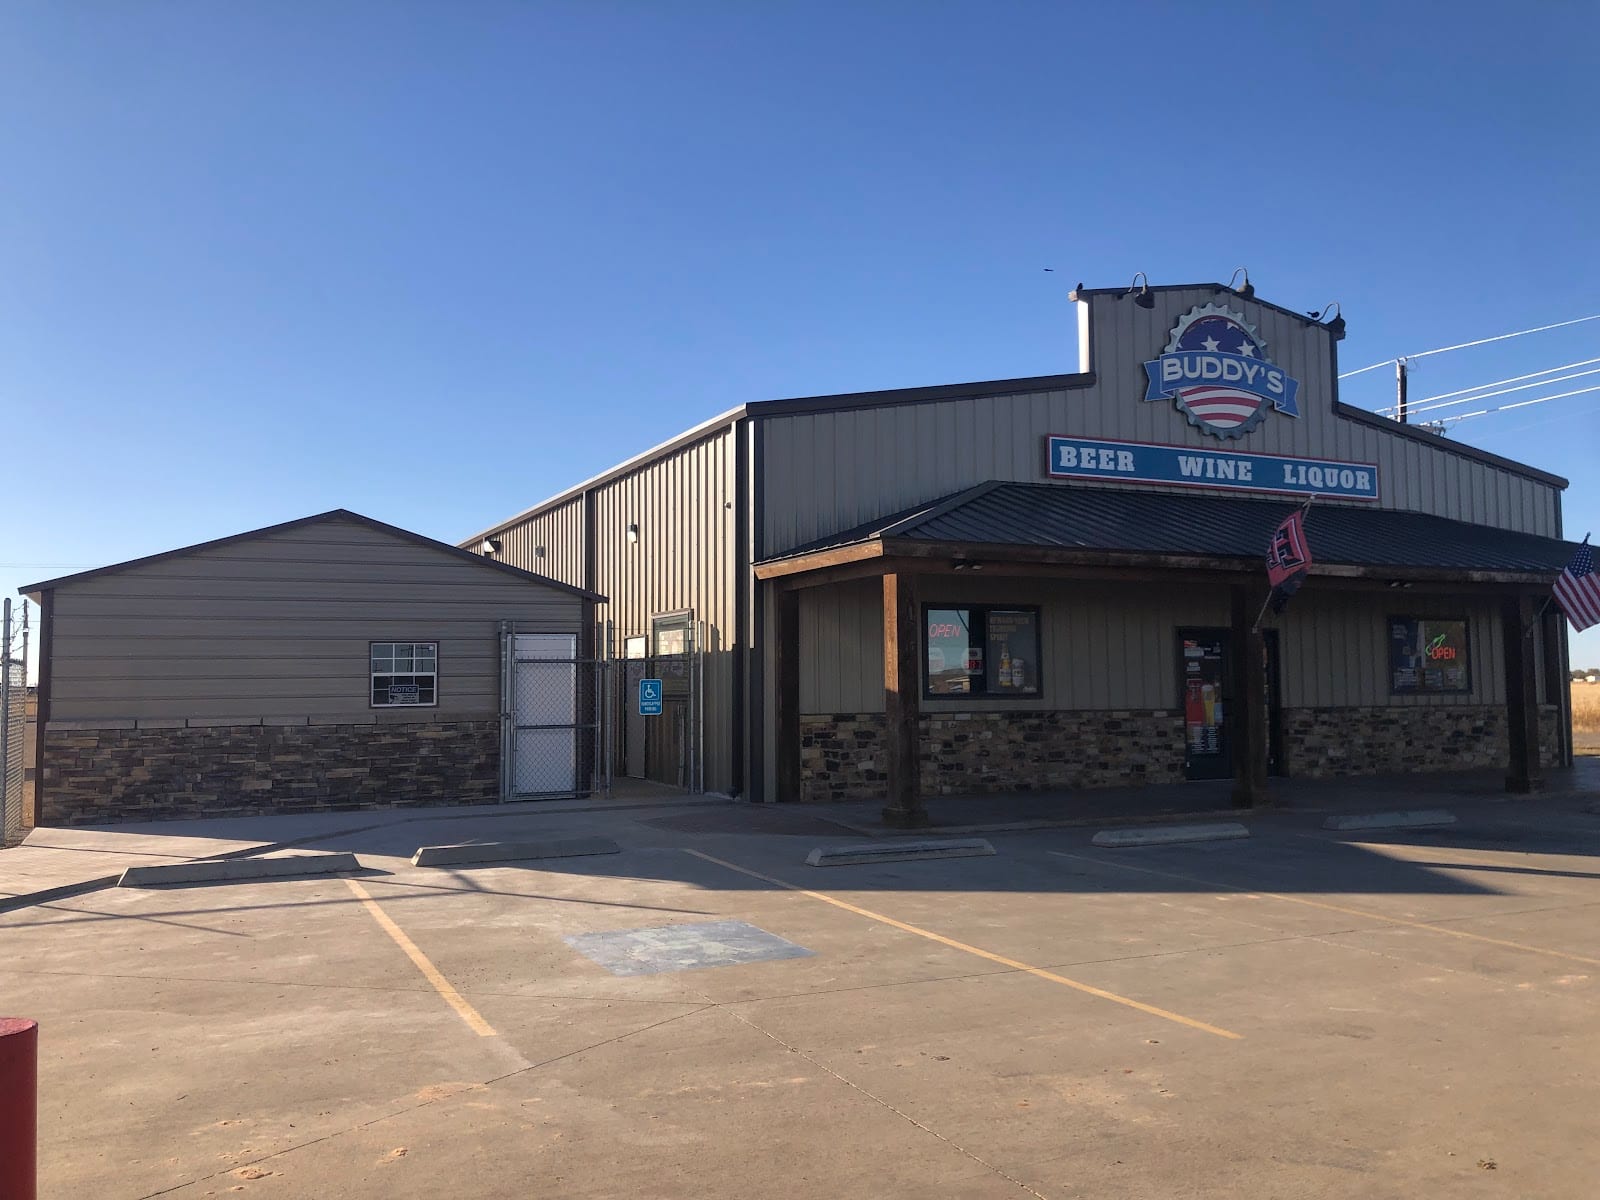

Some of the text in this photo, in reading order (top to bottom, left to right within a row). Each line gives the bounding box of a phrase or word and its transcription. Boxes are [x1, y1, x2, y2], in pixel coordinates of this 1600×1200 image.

[1163, 357, 1284, 394] BUDDY'S
[1059, 445, 1371, 491] BEER WINE LIQUOR
[929, 623, 961, 638] OPEN
[1431, 647, 1456, 660] OPEN
